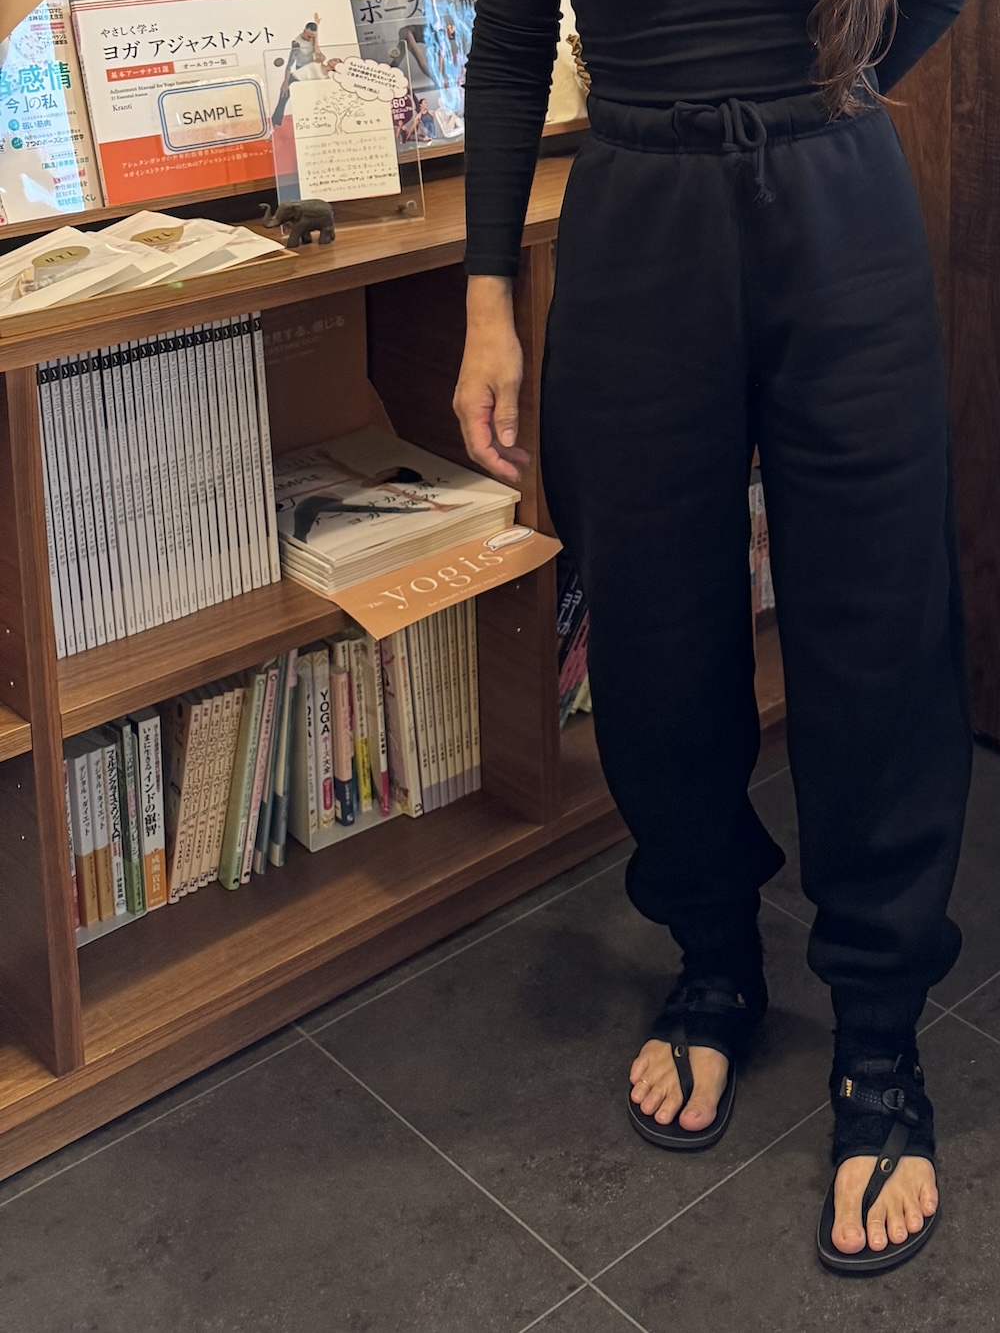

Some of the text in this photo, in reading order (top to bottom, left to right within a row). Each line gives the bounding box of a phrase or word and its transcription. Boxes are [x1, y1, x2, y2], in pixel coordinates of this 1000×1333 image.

[101, 23, 158, 38] やさしく学ぶ
[103, 26, 275, 61] ヨガ アジャストメント
[183, 58, 228, 69] オールカラー版
[110, 86, 137, 95] Adjustment
[163, 81, 175, 89] Yoga
[112, 103, 132, 112] Kranti
[183, 104, 244, 125] SAMPLE
[381, 550, 503, 609] yogis
